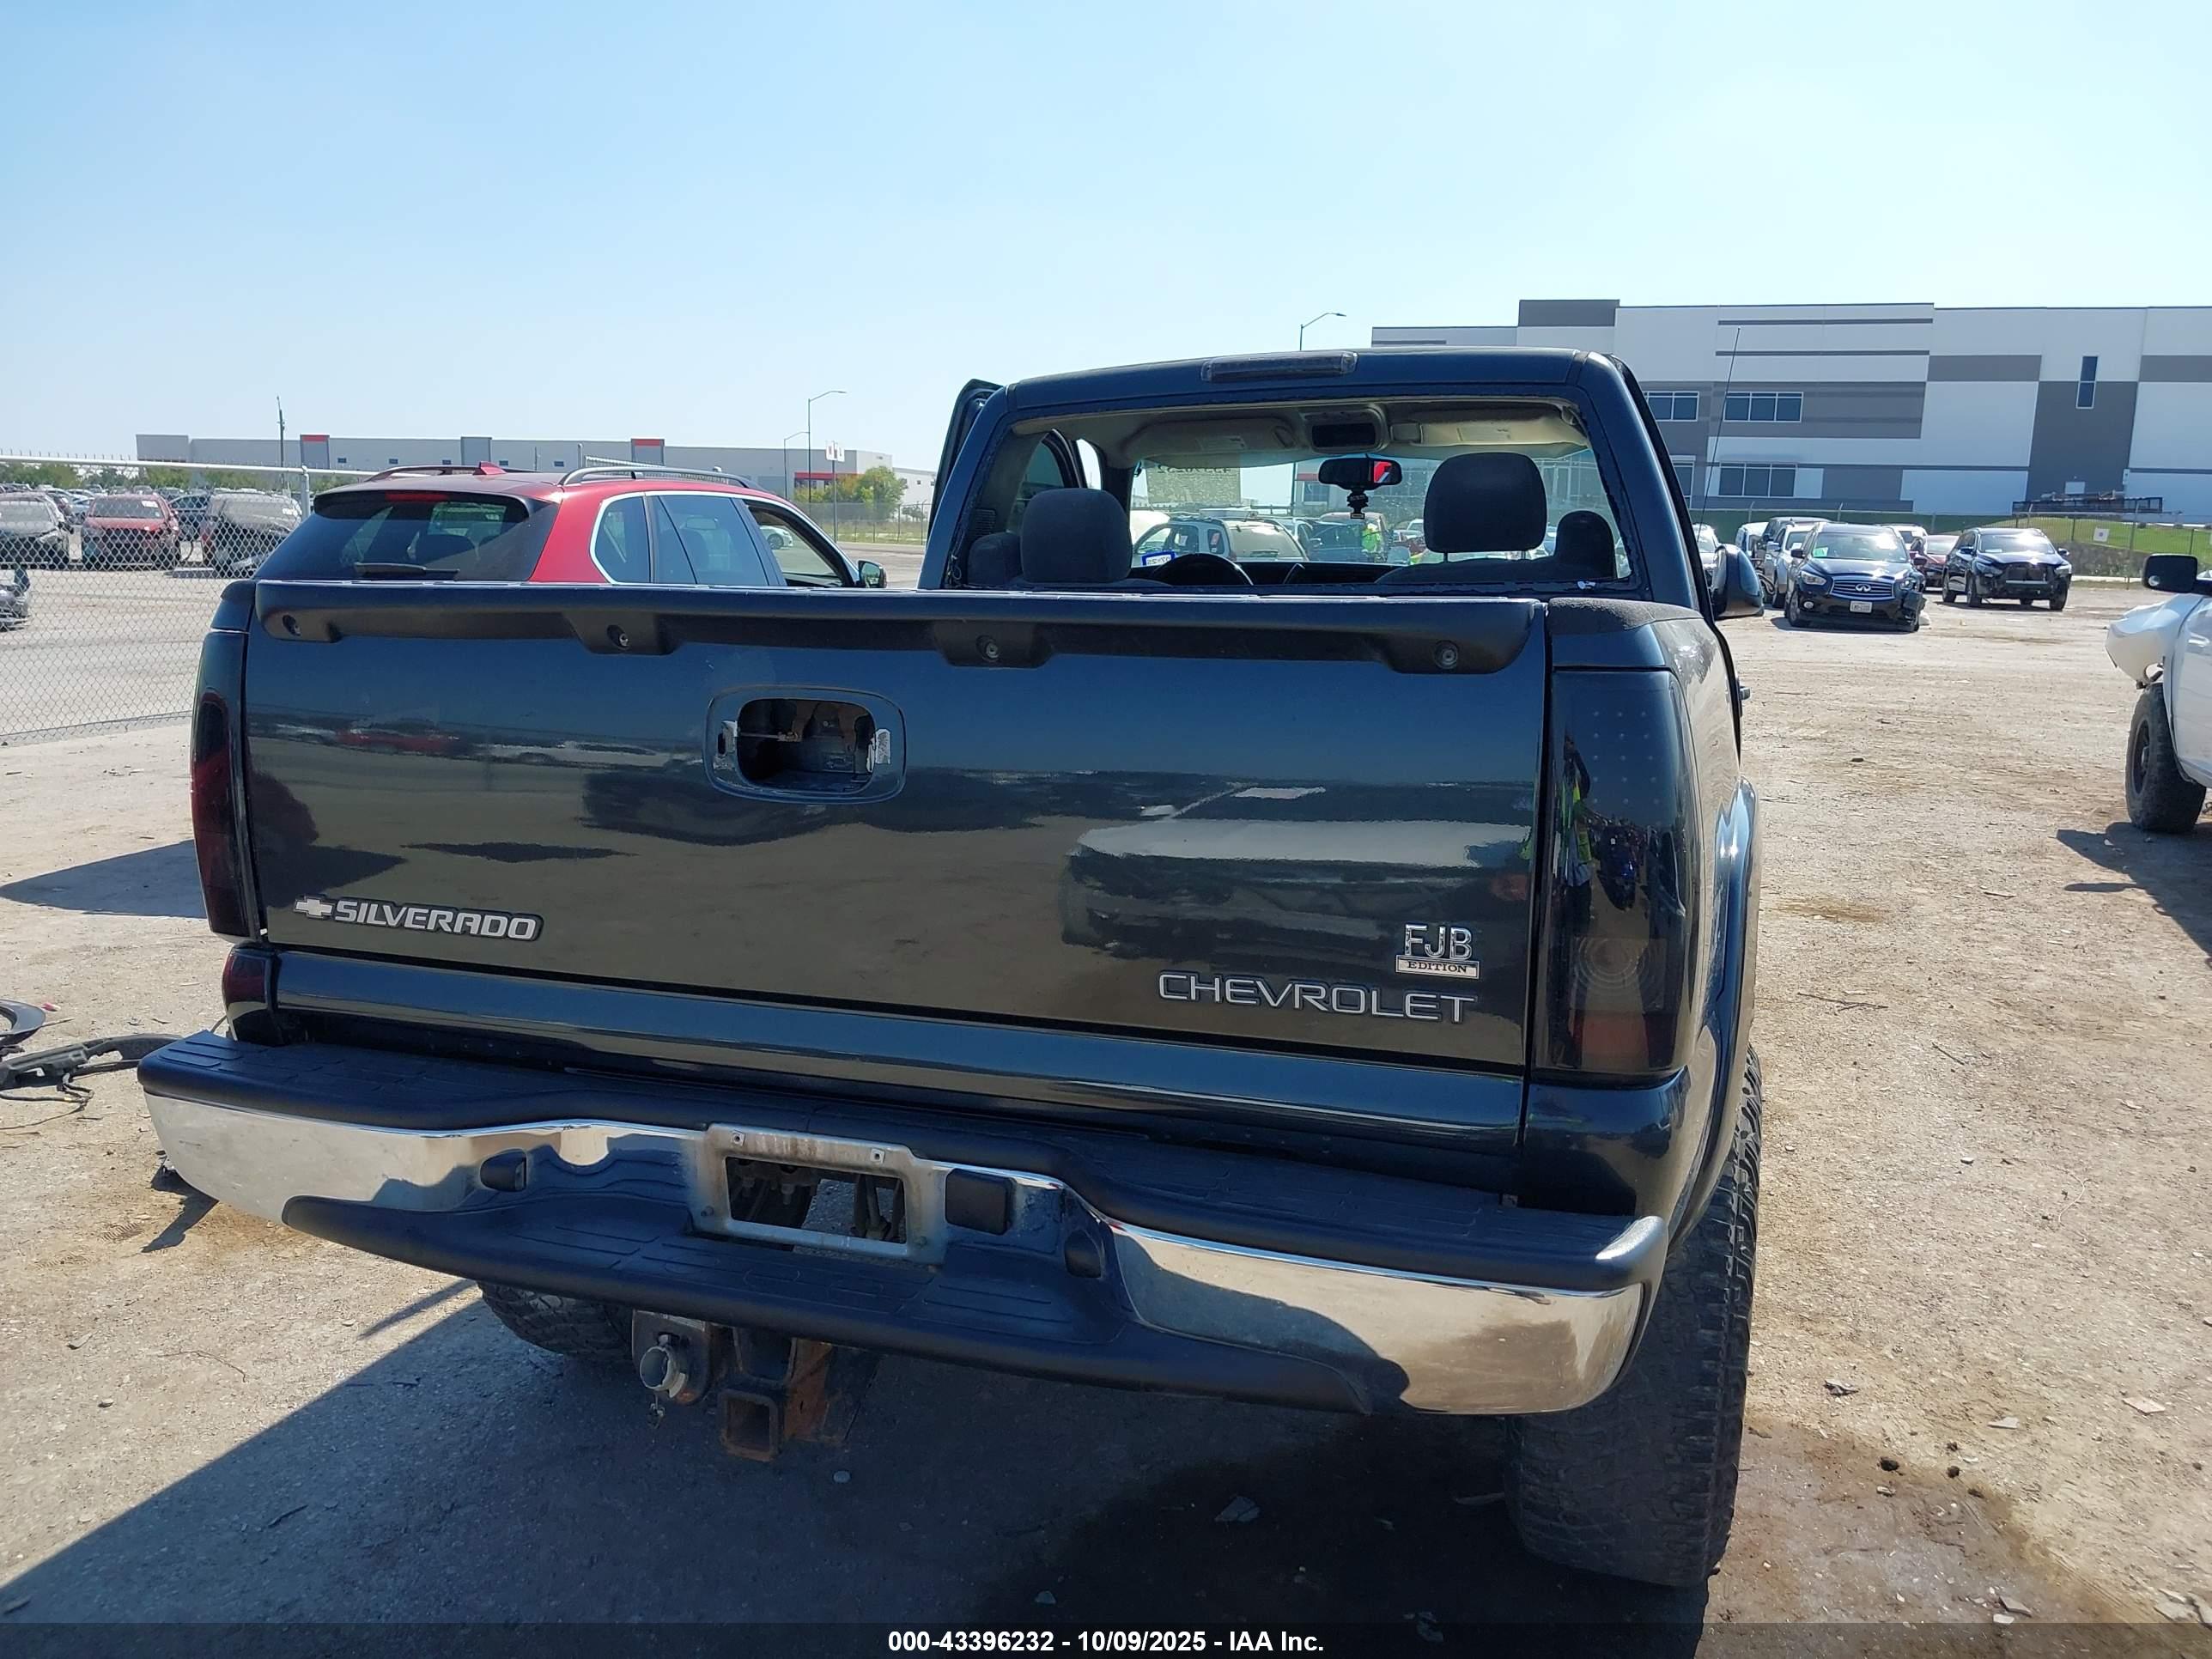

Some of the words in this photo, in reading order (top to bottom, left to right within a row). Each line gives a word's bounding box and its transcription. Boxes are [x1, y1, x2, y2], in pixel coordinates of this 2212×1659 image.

[335, 900, 537, 939] SILVERADO
[1404, 923, 1473, 961] FJB
[1407, 960, 1468, 975] EDITION
[1158, 973, 1476, 1023] CHEVROLET
